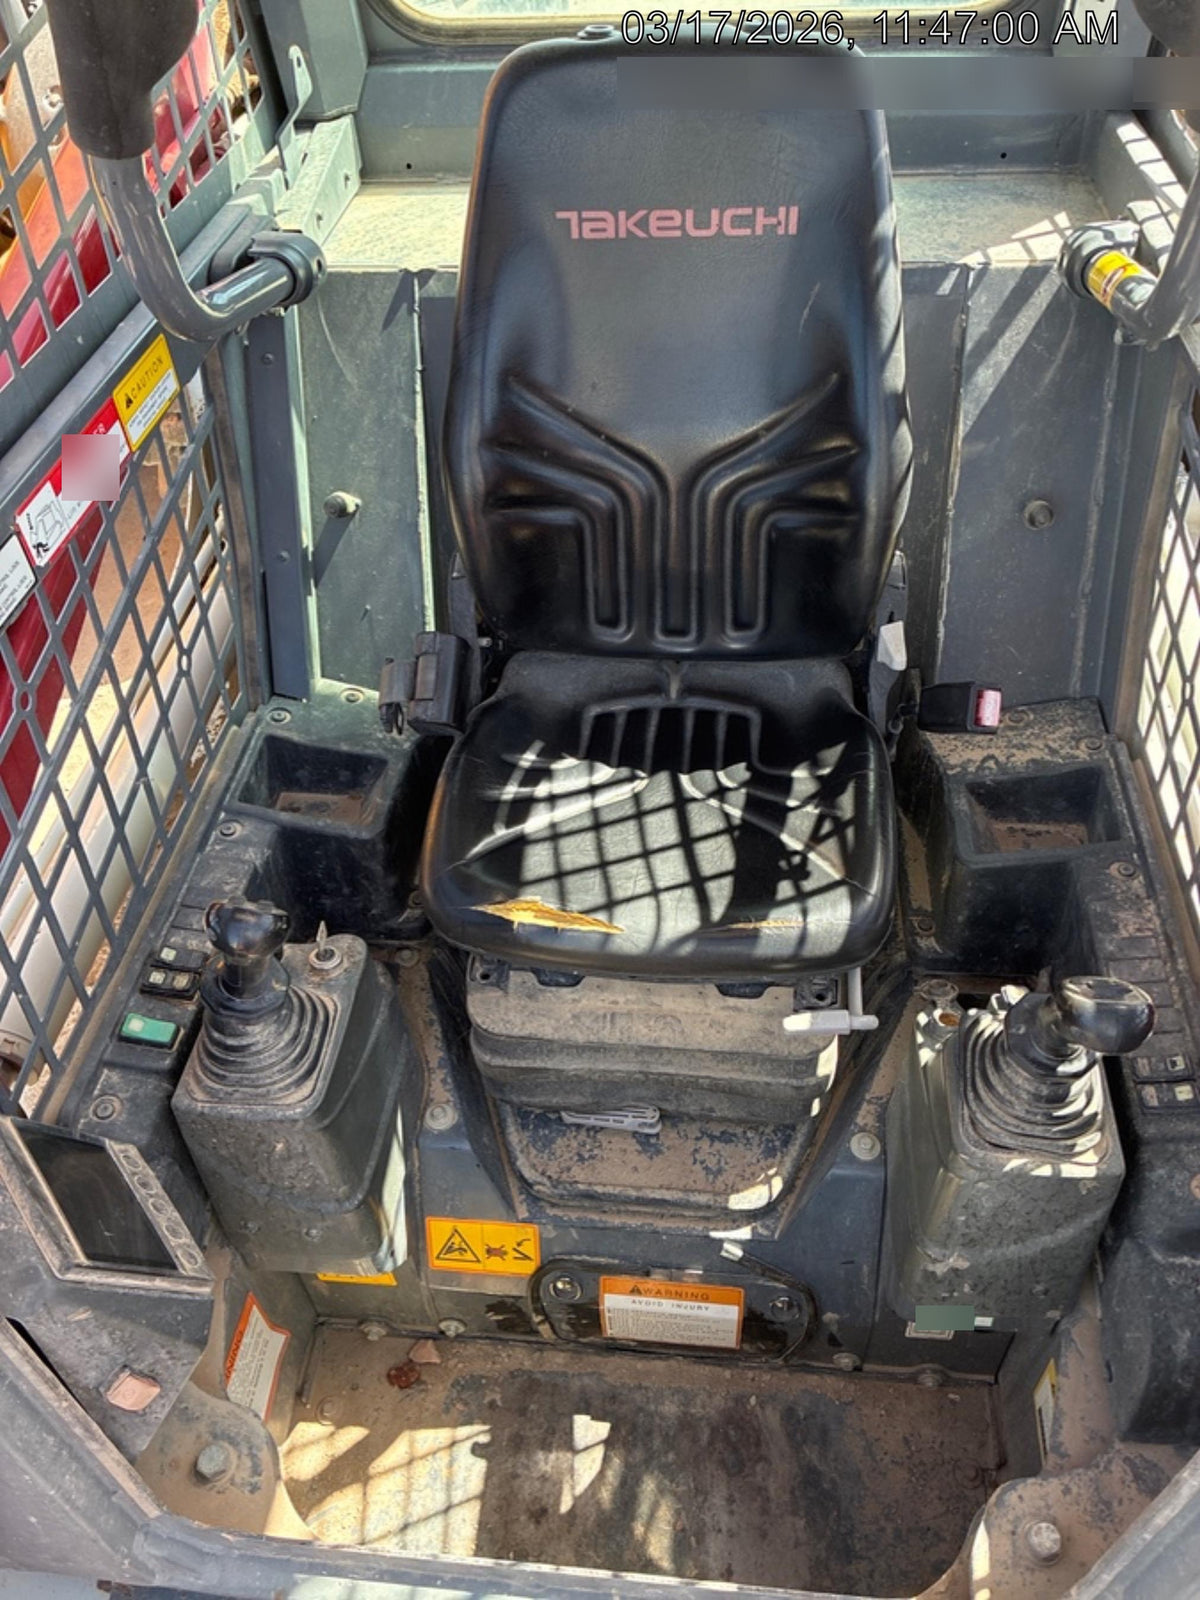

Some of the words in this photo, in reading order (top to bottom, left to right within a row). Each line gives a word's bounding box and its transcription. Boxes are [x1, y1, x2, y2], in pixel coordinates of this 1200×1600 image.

[131, 356, 164, 400] CAUTION
[642, 1287, 711, 1301] WARNING
[631, 1299, 664, 1308] AVOID
[671, 1302, 710, 1312] INJURY
